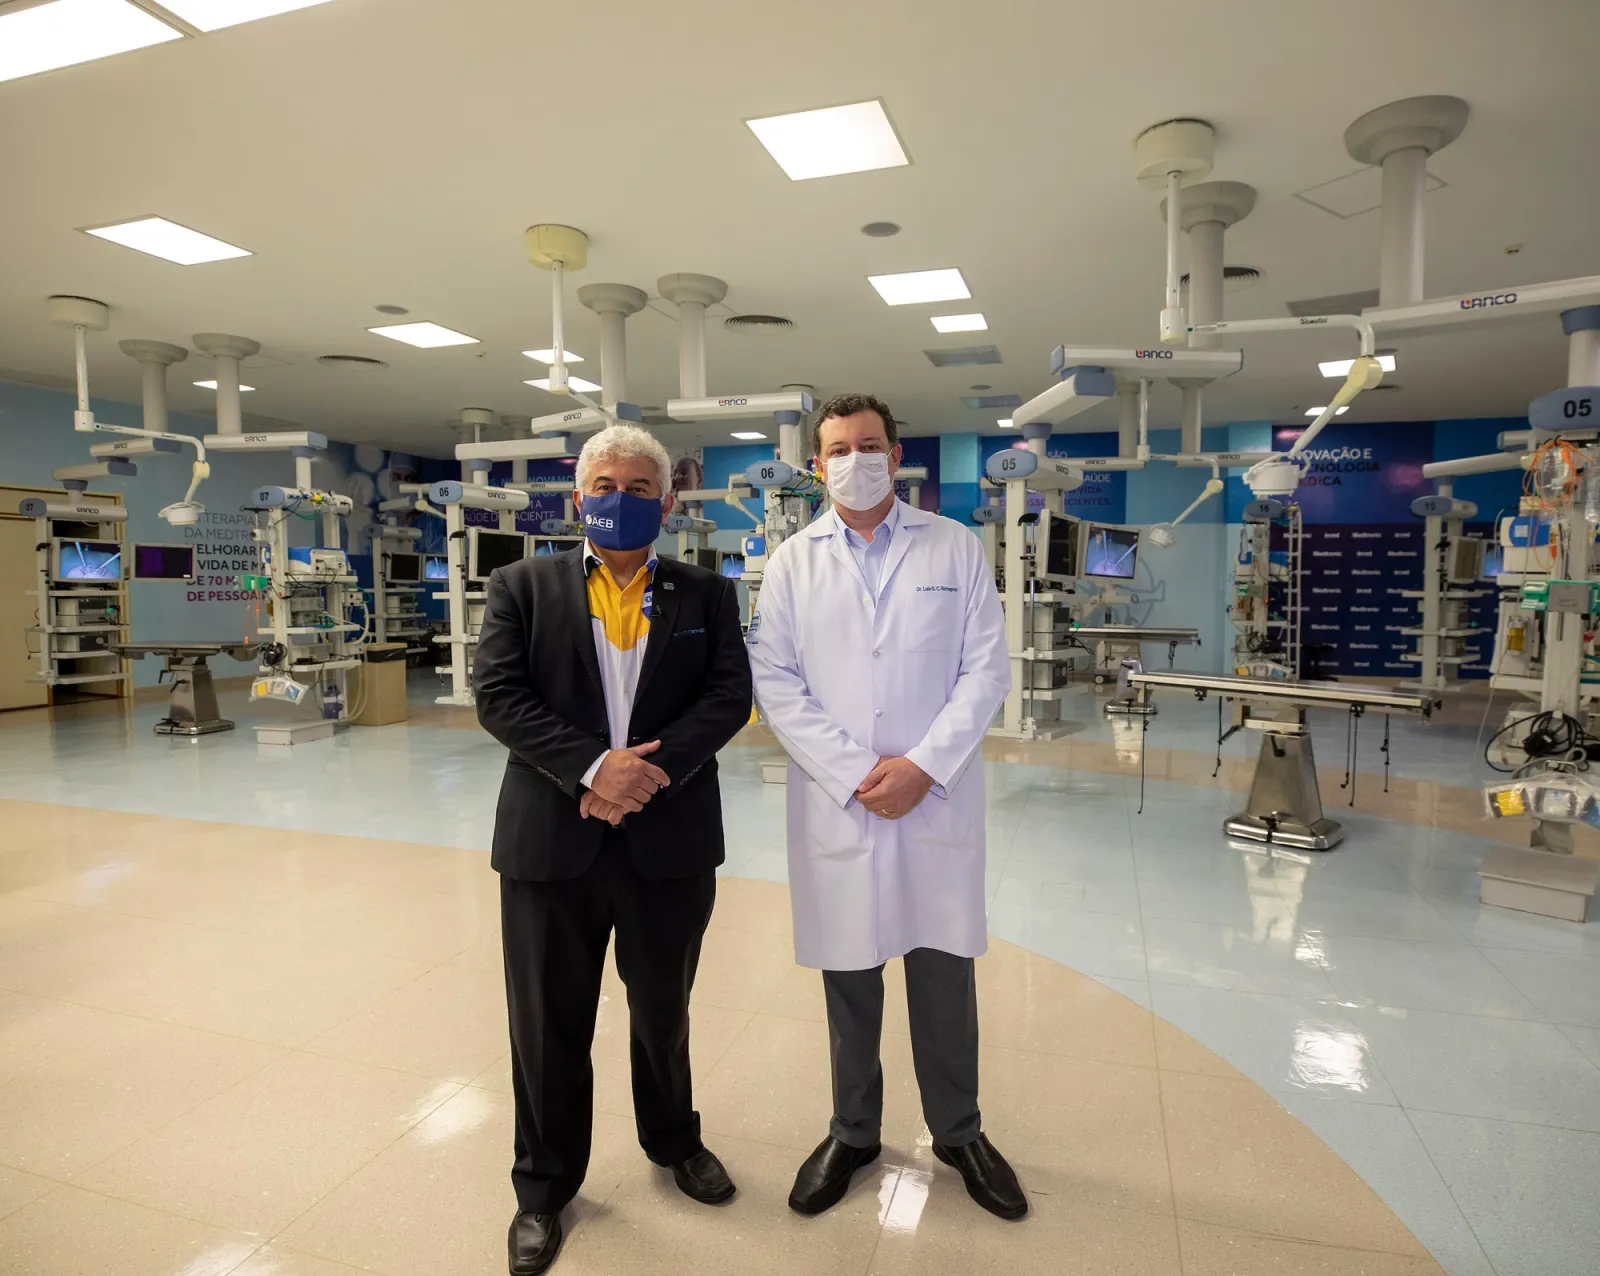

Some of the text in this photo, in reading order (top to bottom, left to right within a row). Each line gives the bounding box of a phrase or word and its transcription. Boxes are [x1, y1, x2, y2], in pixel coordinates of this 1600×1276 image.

[1563, 398, 1592, 418] 05
[1363, 448, 1372, 459] E
[1002, 458, 1016, 470] 05
[761, 467, 774, 479] 06
[1083, 472, 1111, 483] AÚDE
[260, 491, 269, 501] 07
[439, 487, 449, 497] 06
[25, 503, 34, 512] 07
[592, 516, 614, 529] AEB
[184, 526, 204, 539] DA
[197, 559, 229, 571] VIDA
[231, 560, 249, 571] DE
[208, 575, 223, 586] 70
[187, 591, 206, 602] DE
